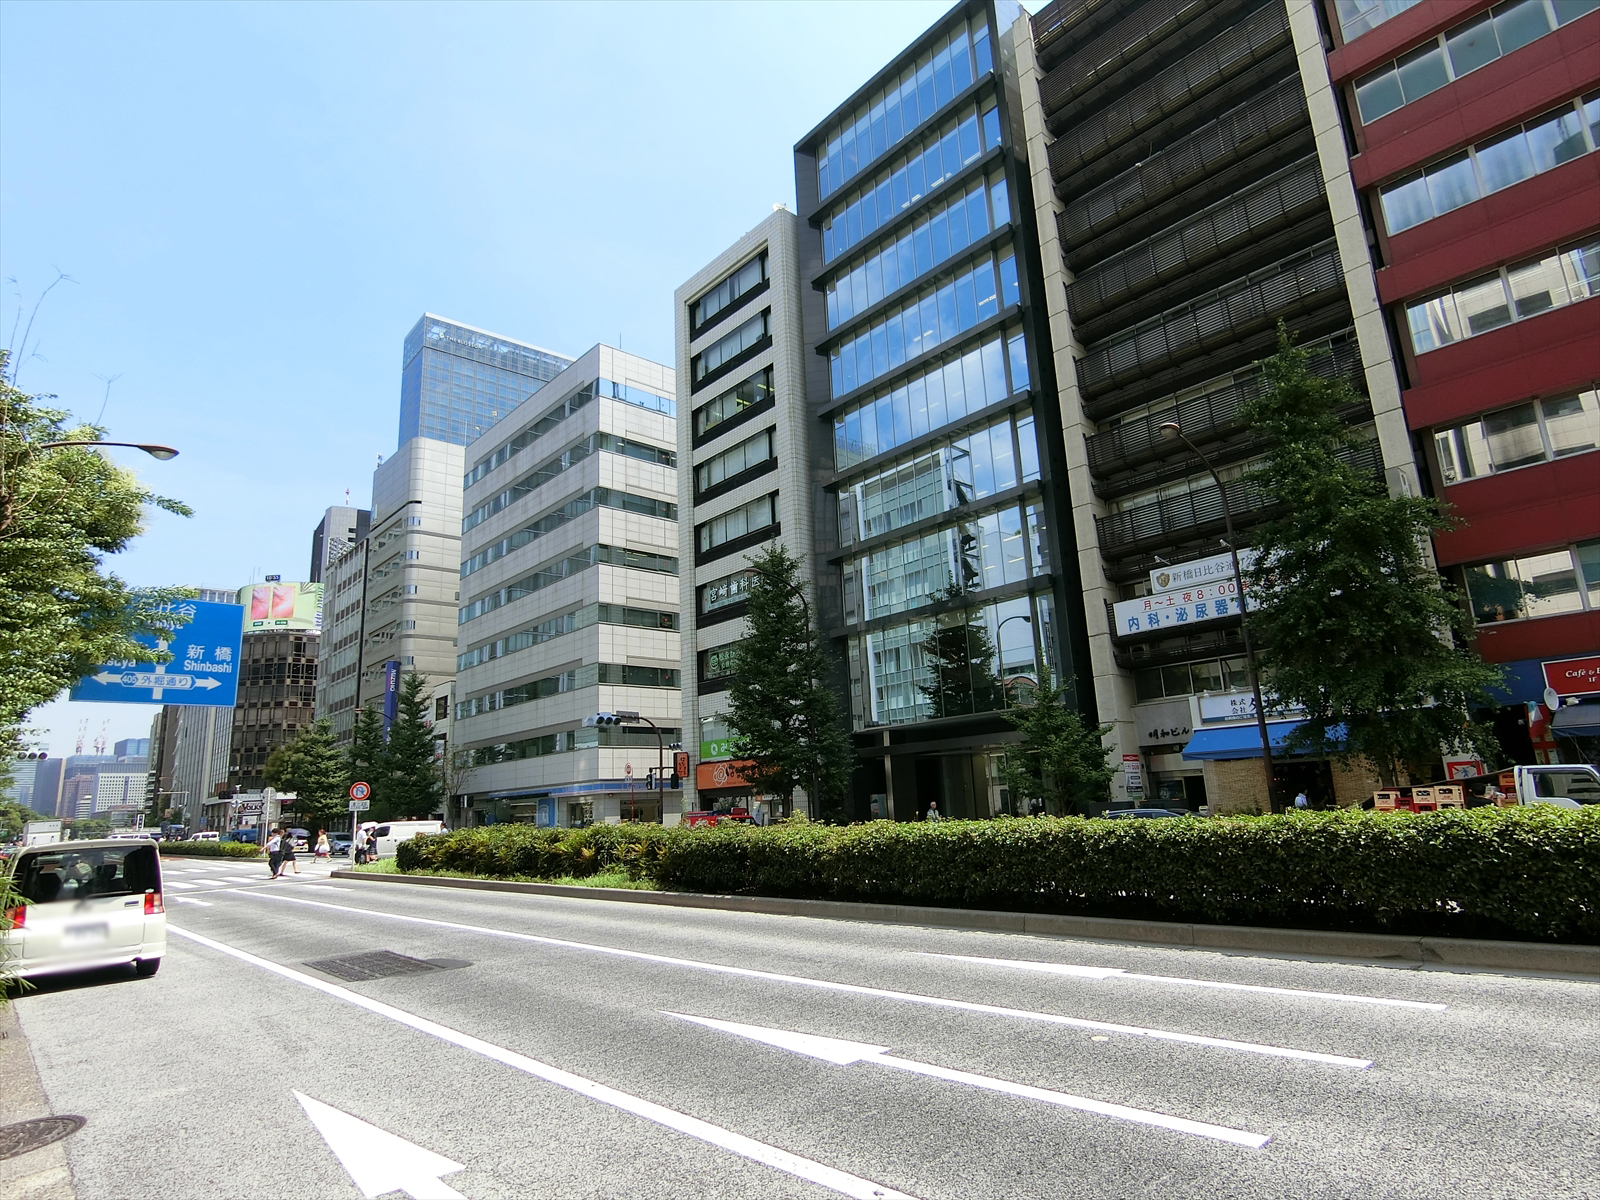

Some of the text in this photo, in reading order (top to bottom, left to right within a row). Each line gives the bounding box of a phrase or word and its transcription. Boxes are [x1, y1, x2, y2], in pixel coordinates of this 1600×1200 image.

[187, 644, 232, 662] 新橋
[184, 660, 232, 673] Shinbashi
[122, 675, 188, 687] 405 外堀通り
